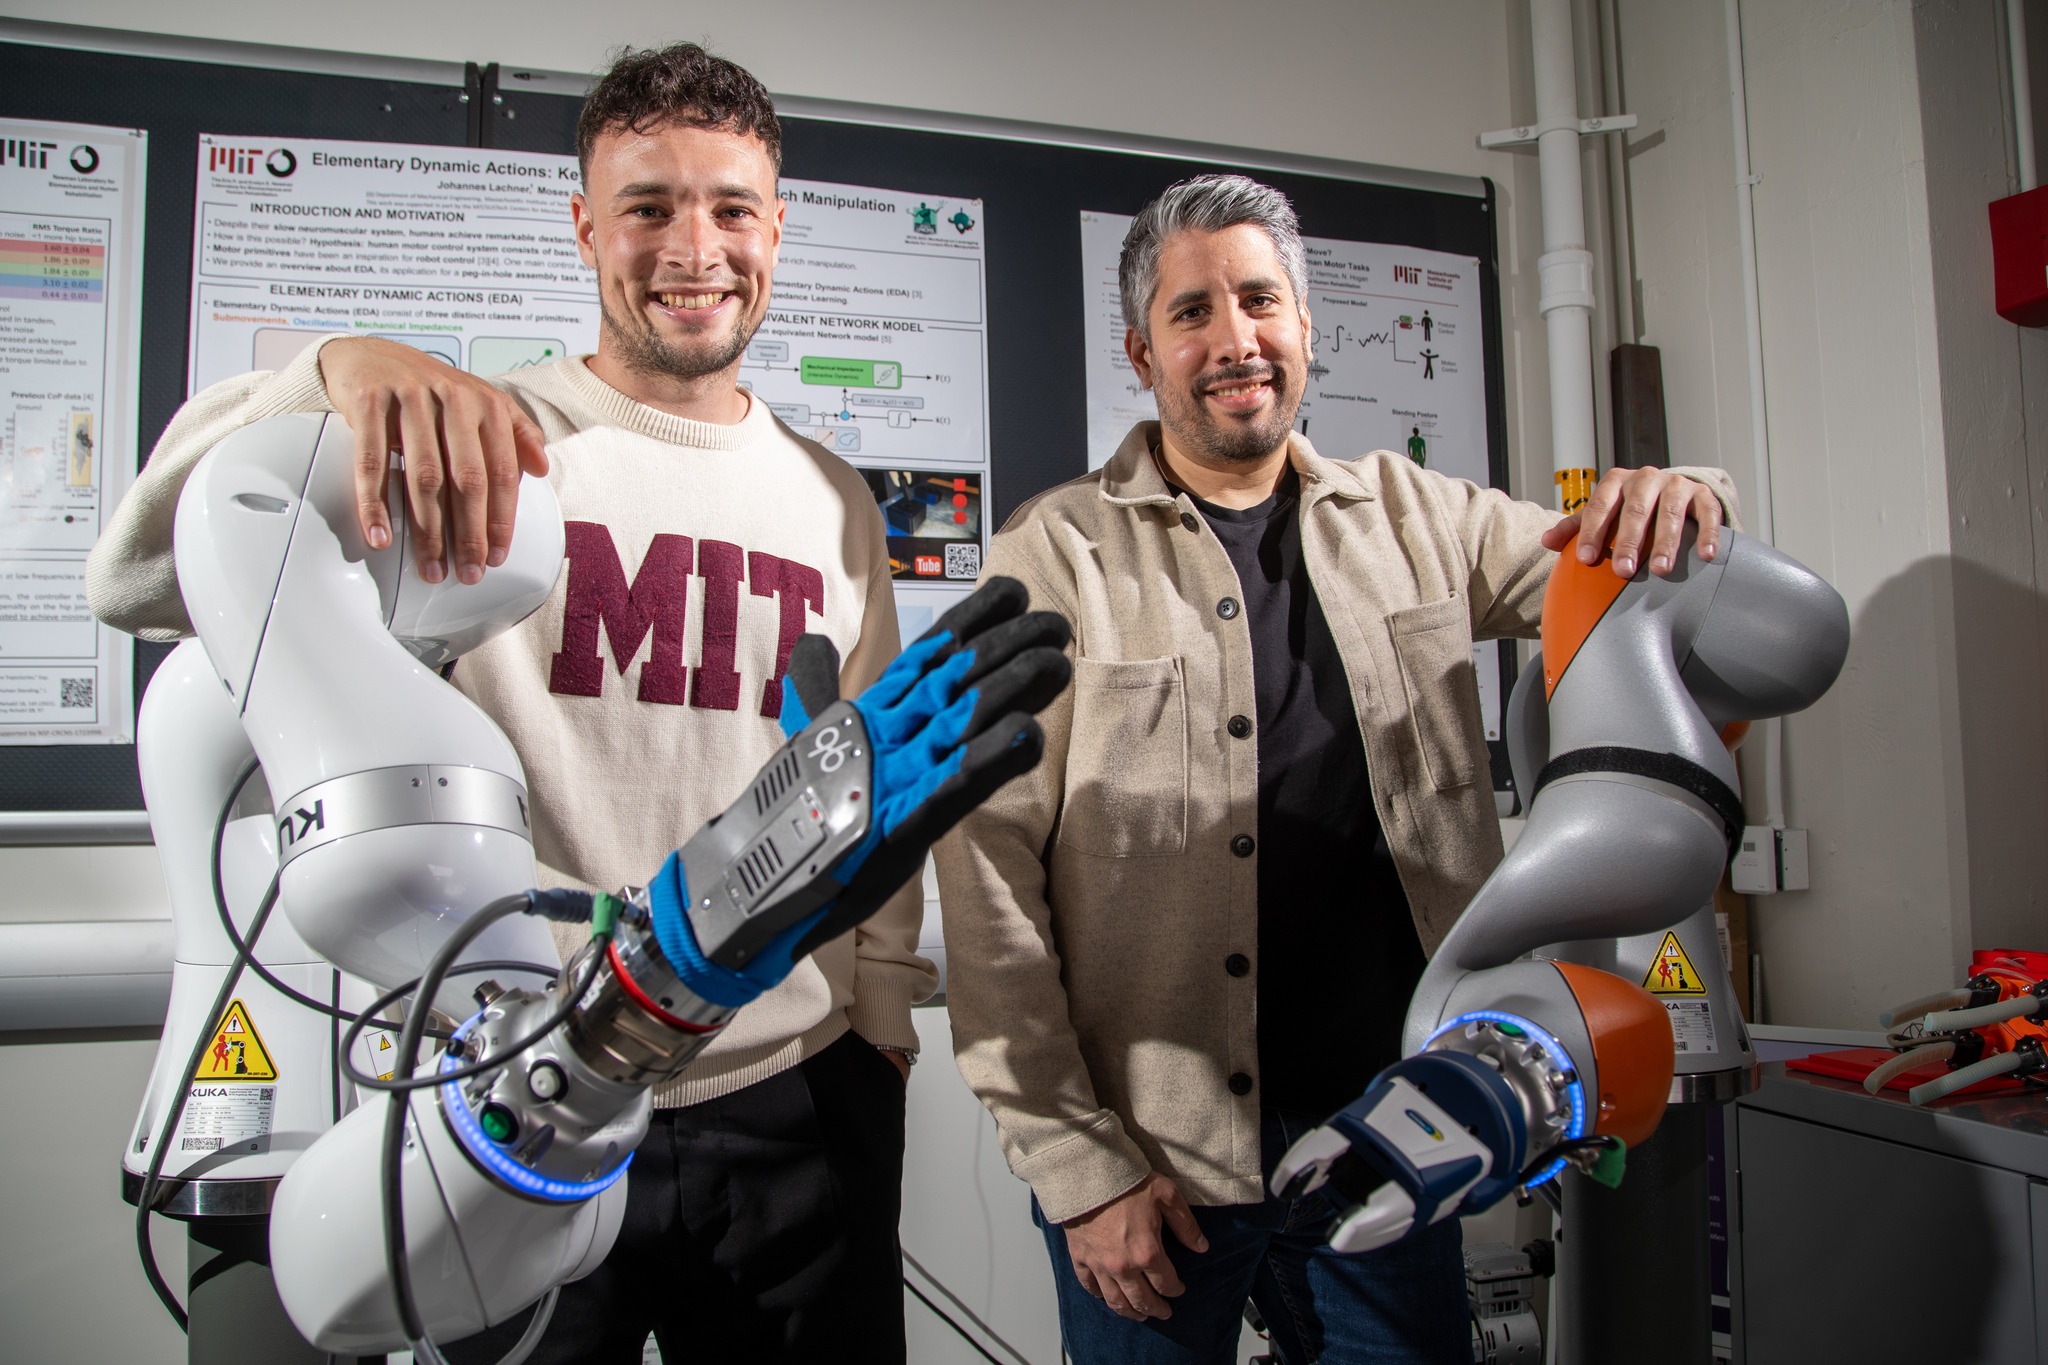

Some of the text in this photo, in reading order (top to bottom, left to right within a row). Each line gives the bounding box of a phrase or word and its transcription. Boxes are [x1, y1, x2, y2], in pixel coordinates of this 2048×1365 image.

[312, 151, 582, 184] Elementary Dynamic Actions: Ke
[437, 180, 487, 191] Johannes
[537, 186, 569, 198] Moses
[802, 190, 896, 213] Manipulation
[250, 202, 352, 219] INTRODUCTION
[356, 207, 384, 219] AND
[386, 209, 465, 222] MOTIVATION
[5, 231, 26, 239] noise
[32, 223, 103, 235] RMS Torque Ratio
[214, 219, 577, 245] Despite their slow neuromuscular system, humans achieve remarkable dexterity
[65, 234, 77, 244] hip
[79, 236, 103, 245] torque
[213, 232, 577, 257] How is this possible? Hypothesis: human motor control system consists of basic
[213, 244, 242, 253] Motor
[244, 246, 291, 258] primitives
[294, 249, 316, 258] have
[318, 251, 341, 260] been
[357, 252, 399, 264] inspiration
[402, 254, 414, 262] for
[416, 255, 441, 263] robot
[443, 256, 475, 264] control
[504, 258, 521, 266] One
[524, 259, 548, 268] main
[549, 260, 577, 269] control
[1306, 247, 1332, 257] Move?
[778, 256, 857, 271] act-rich manipulation.
[1324, 260, 1346, 270] Motor
[1348, 262, 1370, 272] Tasks
[212, 257, 228, 266] We
[230, 258, 263, 269] provide
[266, 261, 278, 269] an
[280, 262, 322, 271] overview
[325, 264, 352, 273] about
[354, 265, 378, 275] EDA,
[379, 266, 389, 275] its
[391, 267, 437, 278] application
[440, 268, 450, 276] for
[461, 269, 511, 281] peg-in-hole
[515, 272, 557, 283] assembly
[1350, 274, 1369, 284] Hogan
[270, 284, 523, 306] ELEMENTARY DYNAMIC ACTIONS (EDA)
[772, 280, 812, 291] lementary
[815, 282, 851, 294] Dynamic
[853, 285, 884, 295] Actions
[886, 287, 911, 299] (EDA)
[811, 294, 848, 305] Learning
[1322, 296, 1368, 308] Proposed Model
[213, 299, 581, 325] Elementary Dynamic Actions (EDA) consist of three distinct classes of primitives:
[23, 316, 57, 326] tandem,
[213, 313, 463, 333] Submovements, Oscillations, Mechanical Impedances
[765, 312, 924, 333] IVALENT NETWORK MODEL
[13, 327, 35, 335] noise
[771, 328, 815, 338] equivalent
[817, 331, 851, 341] Network
[853, 333, 879, 342] model
[28, 337, 77, 348] ankle torque
[36, 348, 64, 356] studies
[5, 356, 88, 367] torque limited due to
[806, 364, 836, 372] Mechanical
[11, 391, 46, 400] Previous
[47, 392, 63, 401] CoP
[64, 393, 82, 401] data
[1319, 392, 1378, 404] Experimental Results
[1391, 408, 1438, 420] Standing Posture
[917, 557, 941, 573] Tube
[549, 520, 824, 720] MIT
[189, 1087, 229, 1098] KUKA
